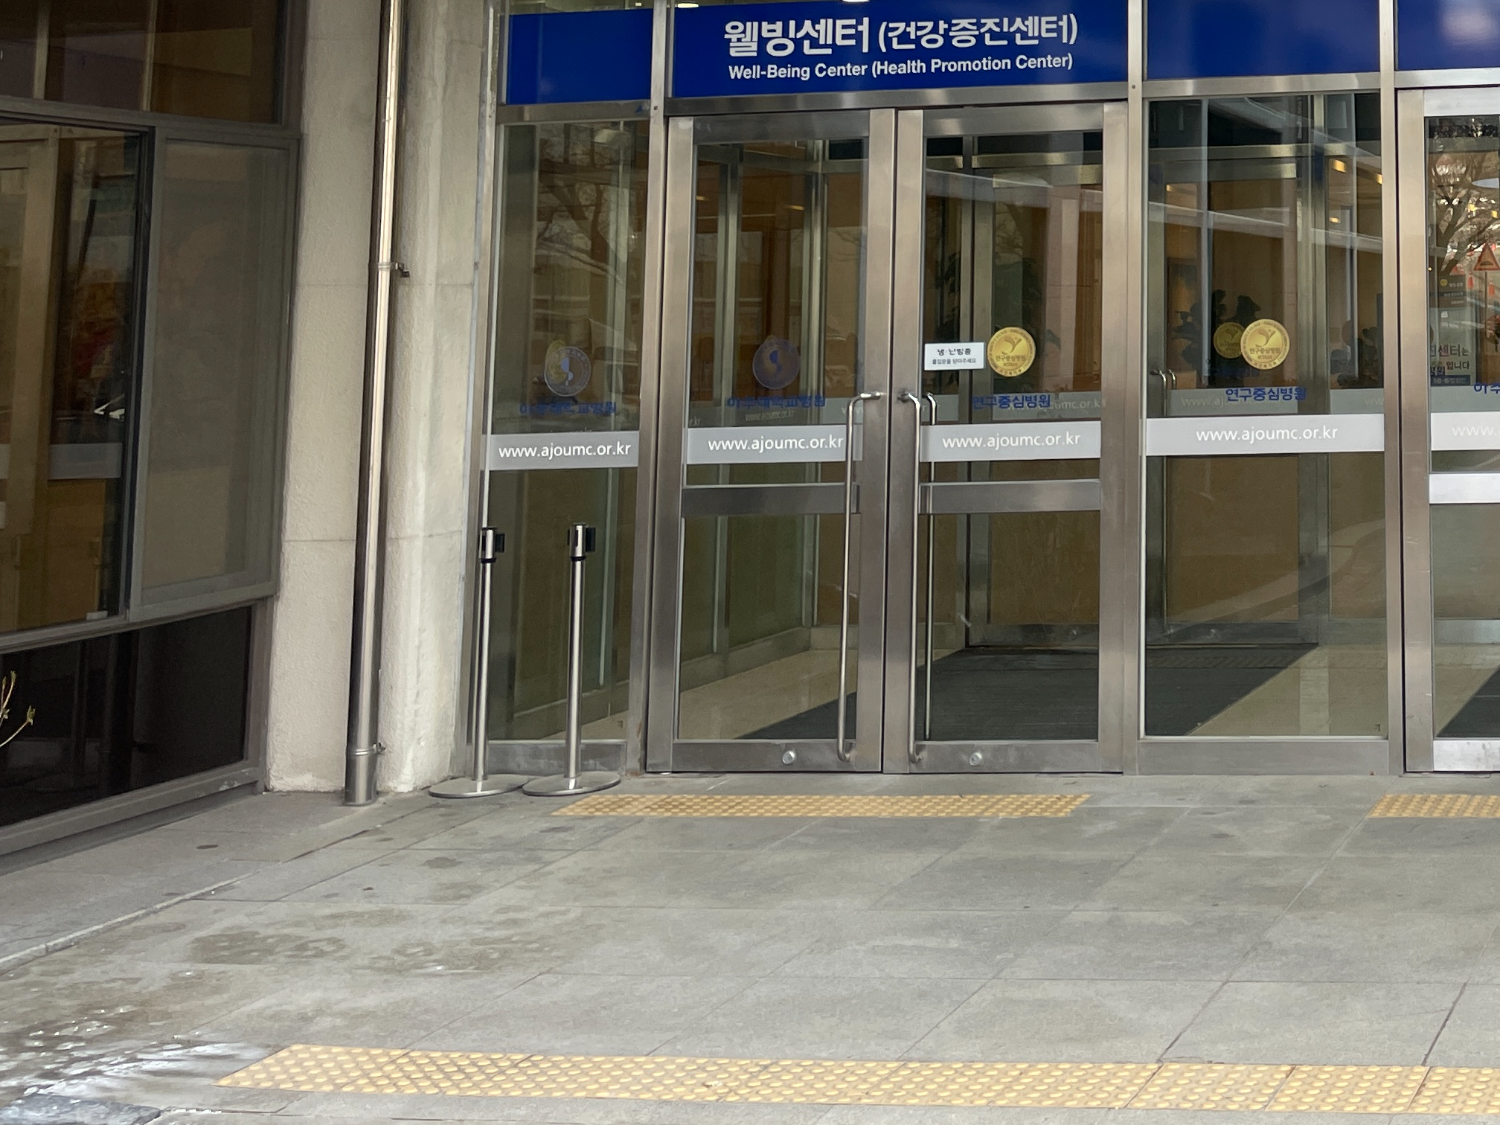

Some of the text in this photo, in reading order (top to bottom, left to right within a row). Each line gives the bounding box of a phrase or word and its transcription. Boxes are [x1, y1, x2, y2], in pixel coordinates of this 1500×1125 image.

[723, 13, 1079, 58] 웰빙센터 (건강증진센터)
[728, 52, 1074, 81] Well-Being Center (Health Promotion Center)
[1225, 386, 1307, 402] 연구중심병원
[708, 434, 844, 453] www.ajoumc.or.kr
[942, 431, 1081, 450] www.ajoumc.or.kr
[1195, 425, 1339, 444] www.ajoumc.or.kr
[498, 442, 632, 461] www.ajoumc.or.kr
